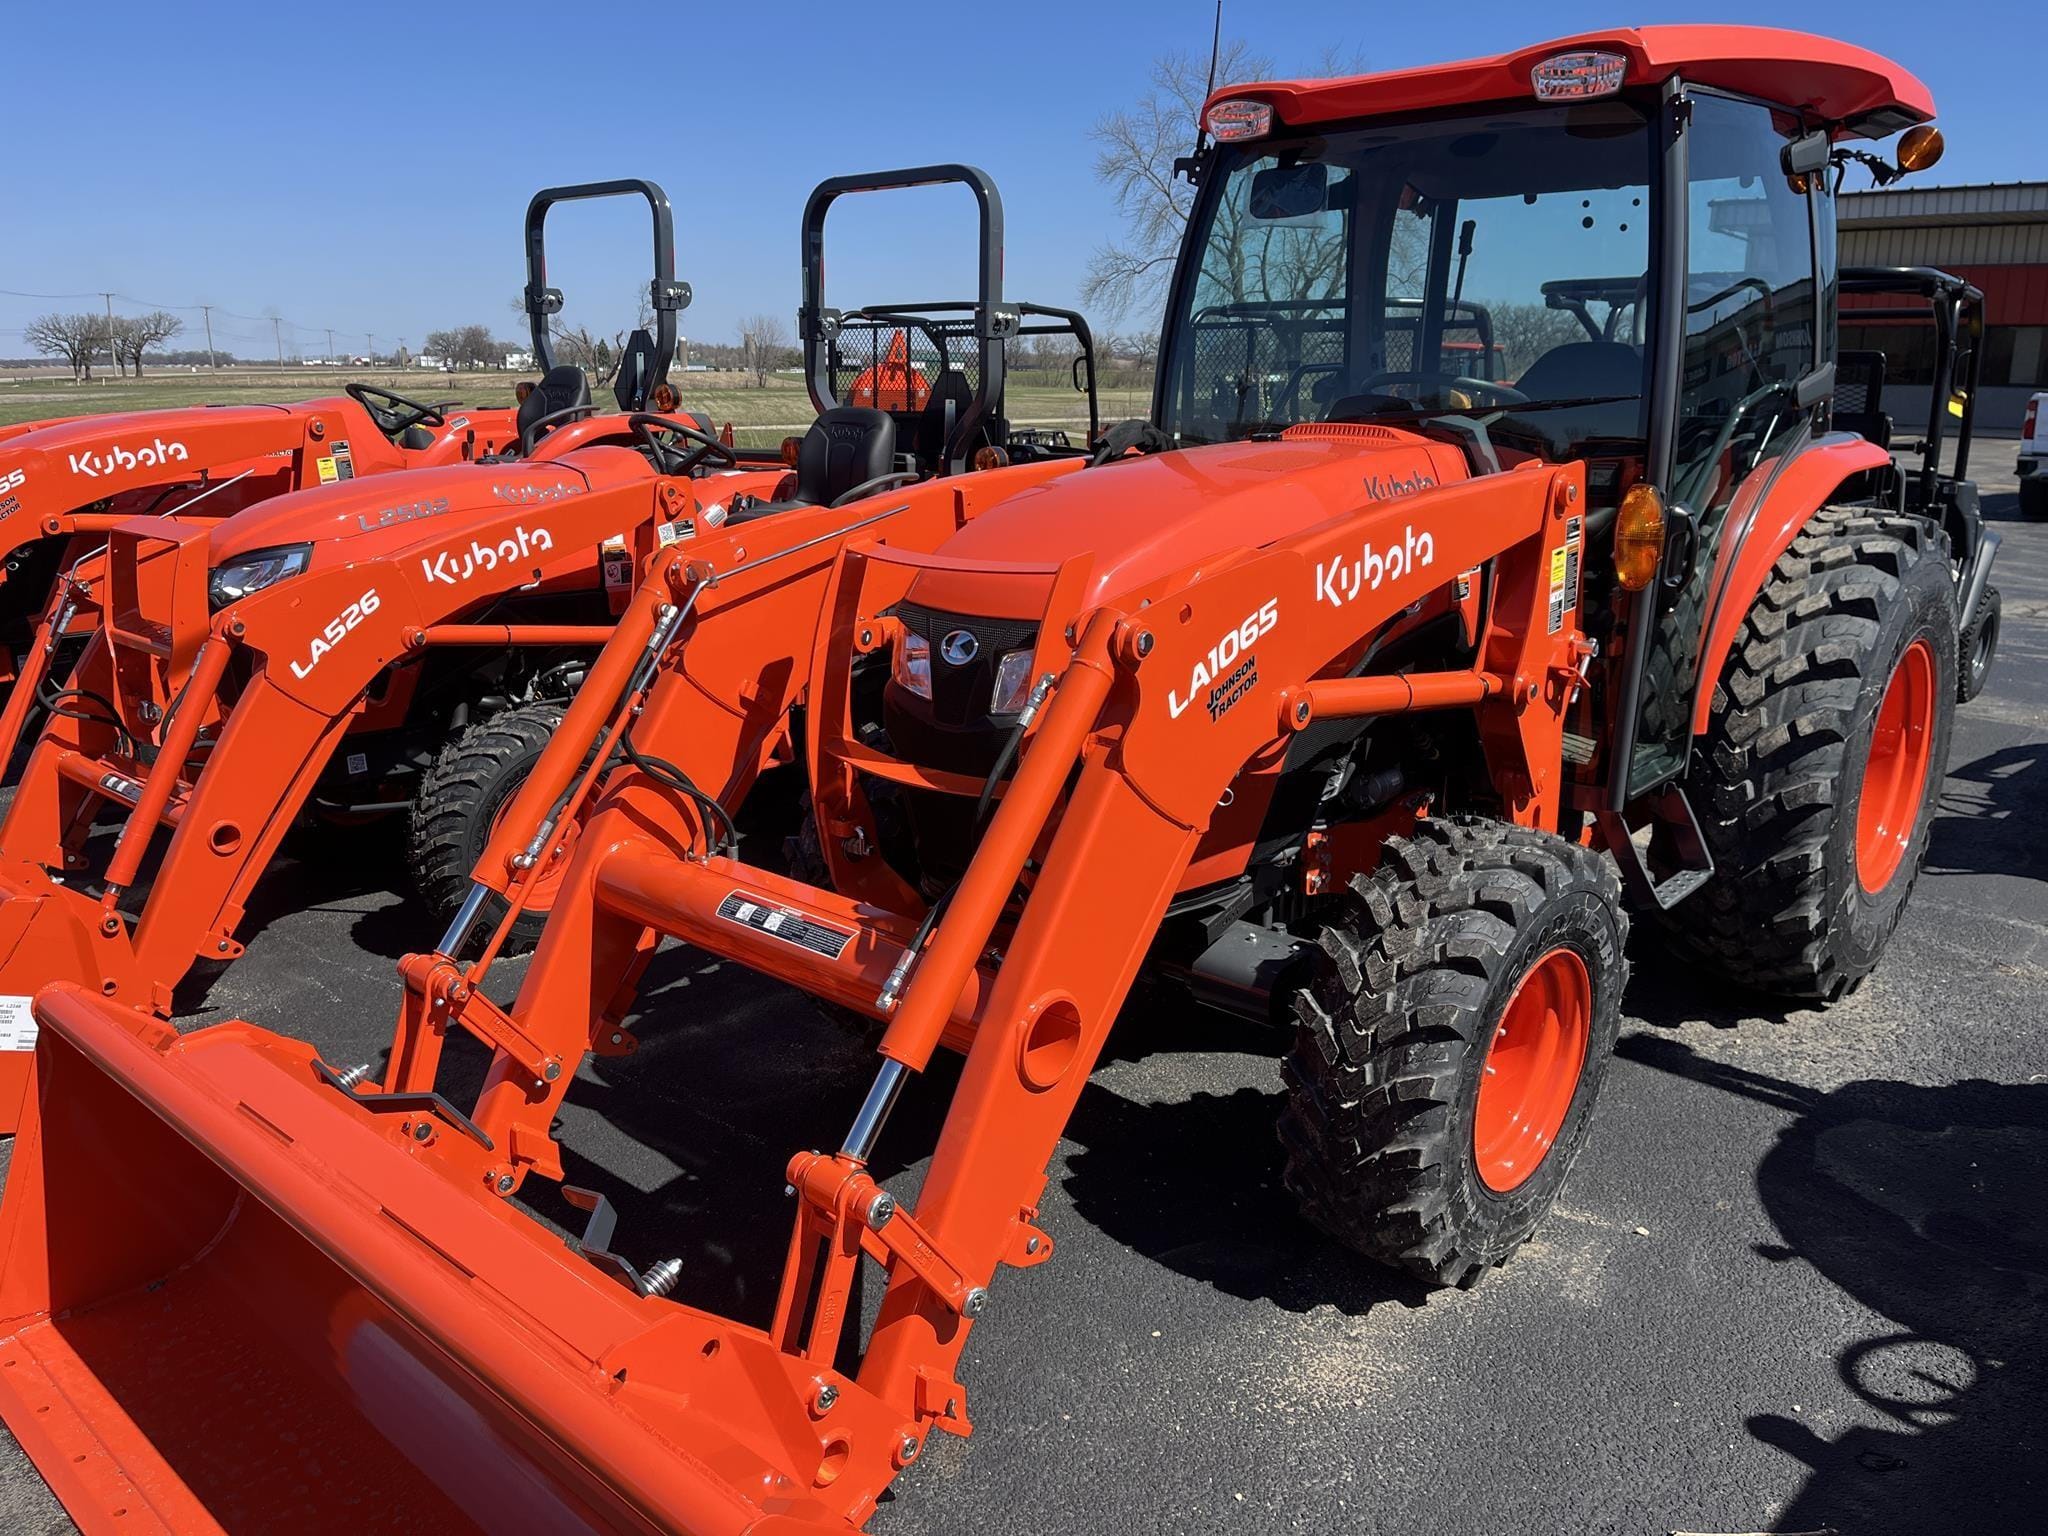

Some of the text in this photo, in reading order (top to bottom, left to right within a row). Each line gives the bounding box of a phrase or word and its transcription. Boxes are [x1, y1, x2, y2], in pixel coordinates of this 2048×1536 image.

[68, 438, 189, 478] Kubota
[492, 482, 582, 504] Kubota
[1362, 470, 1435, 501] Kubota
[358, 497, 450, 532] L2502
[421, 525, 553, 585] Kubota
[1316, 524, 1434, 608] Kubota
[288, 587, 381, 680] LA526
[1167, 596, 1279, 720] LA1065
[1206, 655, 1255, 710] JOHNSON
[1209, 671, 1258, 723] TRACTOR
